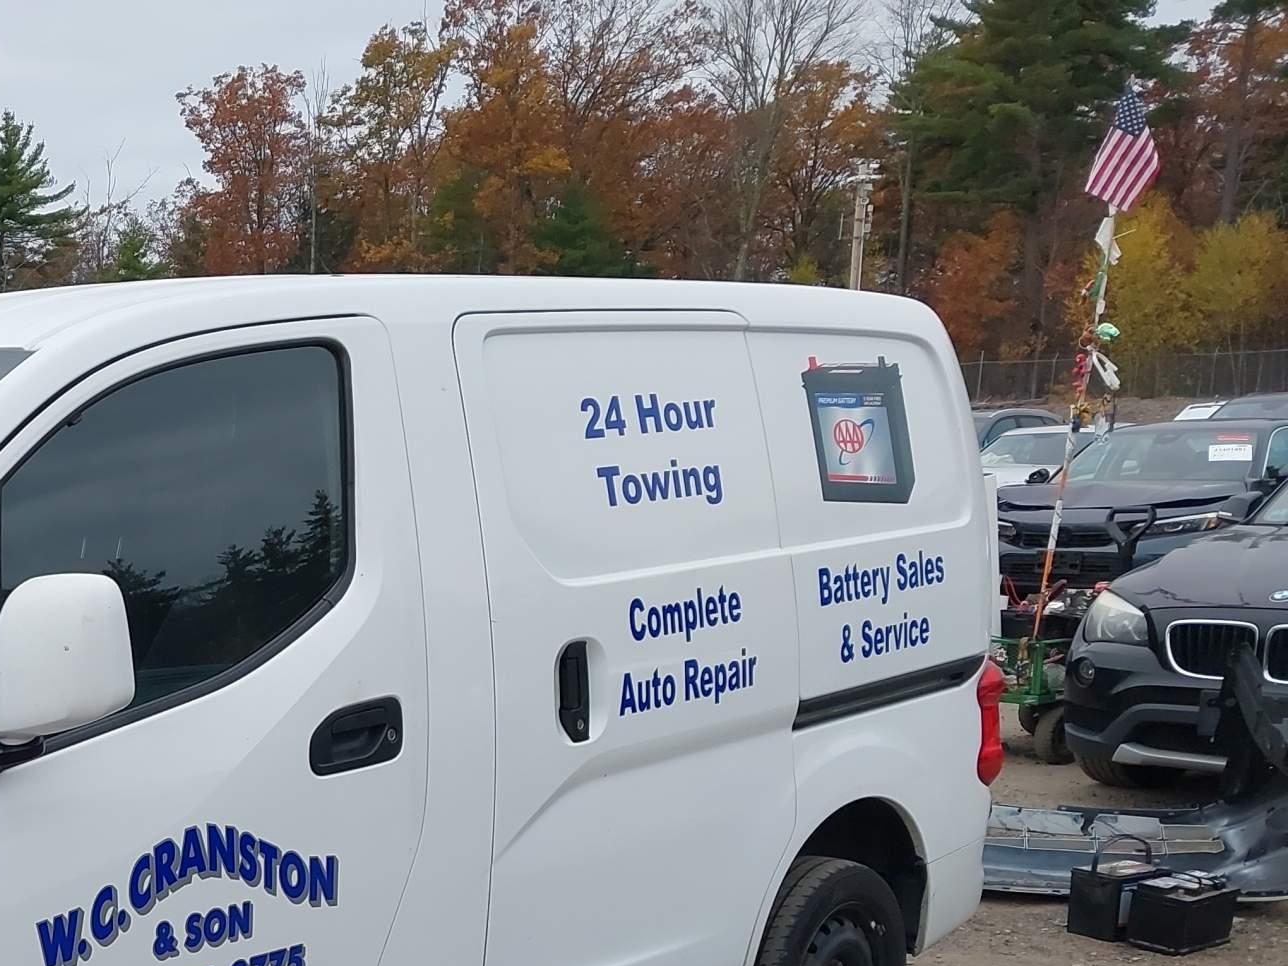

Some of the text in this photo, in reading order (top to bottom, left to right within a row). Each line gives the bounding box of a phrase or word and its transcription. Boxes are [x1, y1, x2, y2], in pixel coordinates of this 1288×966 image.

[580, 392, 716, 440] 24 Hour
[597, 459, 724, 506] Towing
[817, 550, 946, 607] Battery Sales
[628, 585, 743, 642] Complete
[839, 612, 931, 664] & Service
[618, 648, 758, 717] Auto Repair
[128, 822, 339, 908] CRANSTON
[152, 900, 253, 961] & SON
